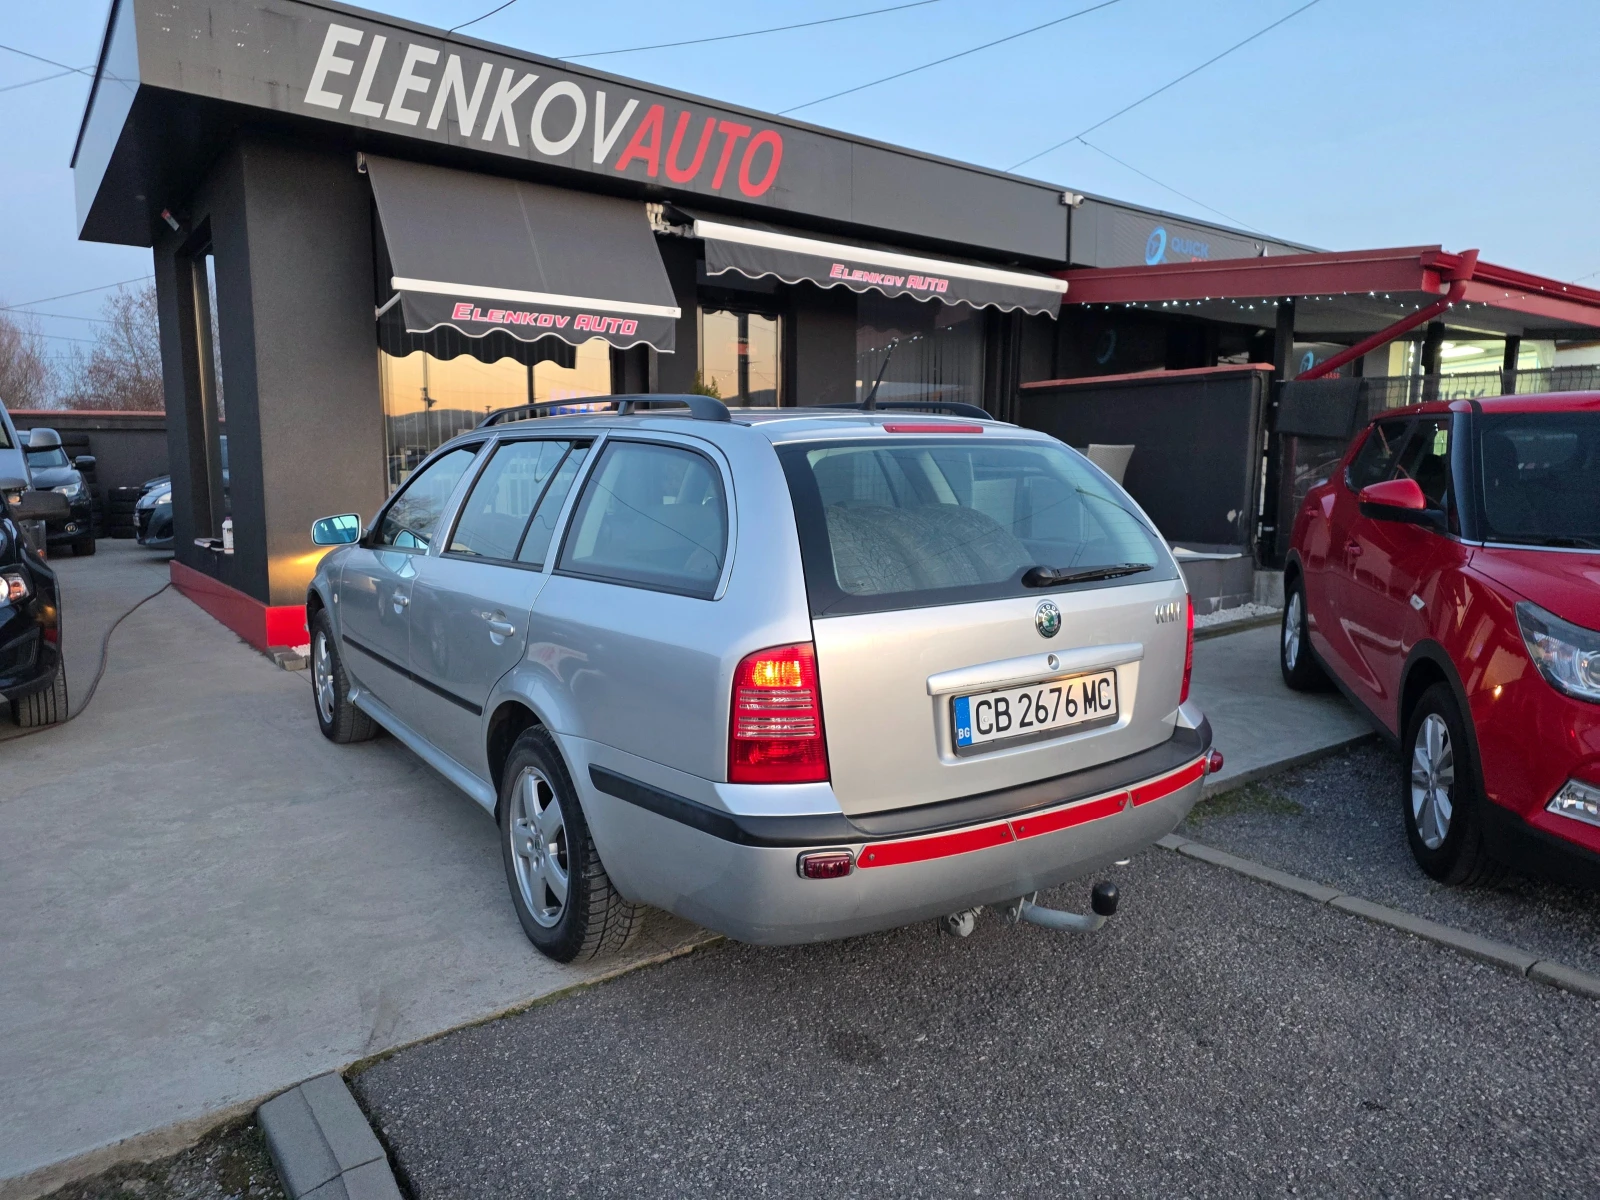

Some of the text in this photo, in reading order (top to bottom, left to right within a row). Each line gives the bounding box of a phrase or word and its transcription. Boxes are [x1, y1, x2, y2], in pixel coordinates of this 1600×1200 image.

[1171, 237, 1209, 259] QUICK
[829, 263, 949, 293] ELENKOV AUTO
[451, 302, 638, 335] ELENKOV AUTO
[975, 677, 1112, 735] CB 2676 MC
[958, 727, 971, 740] BG
